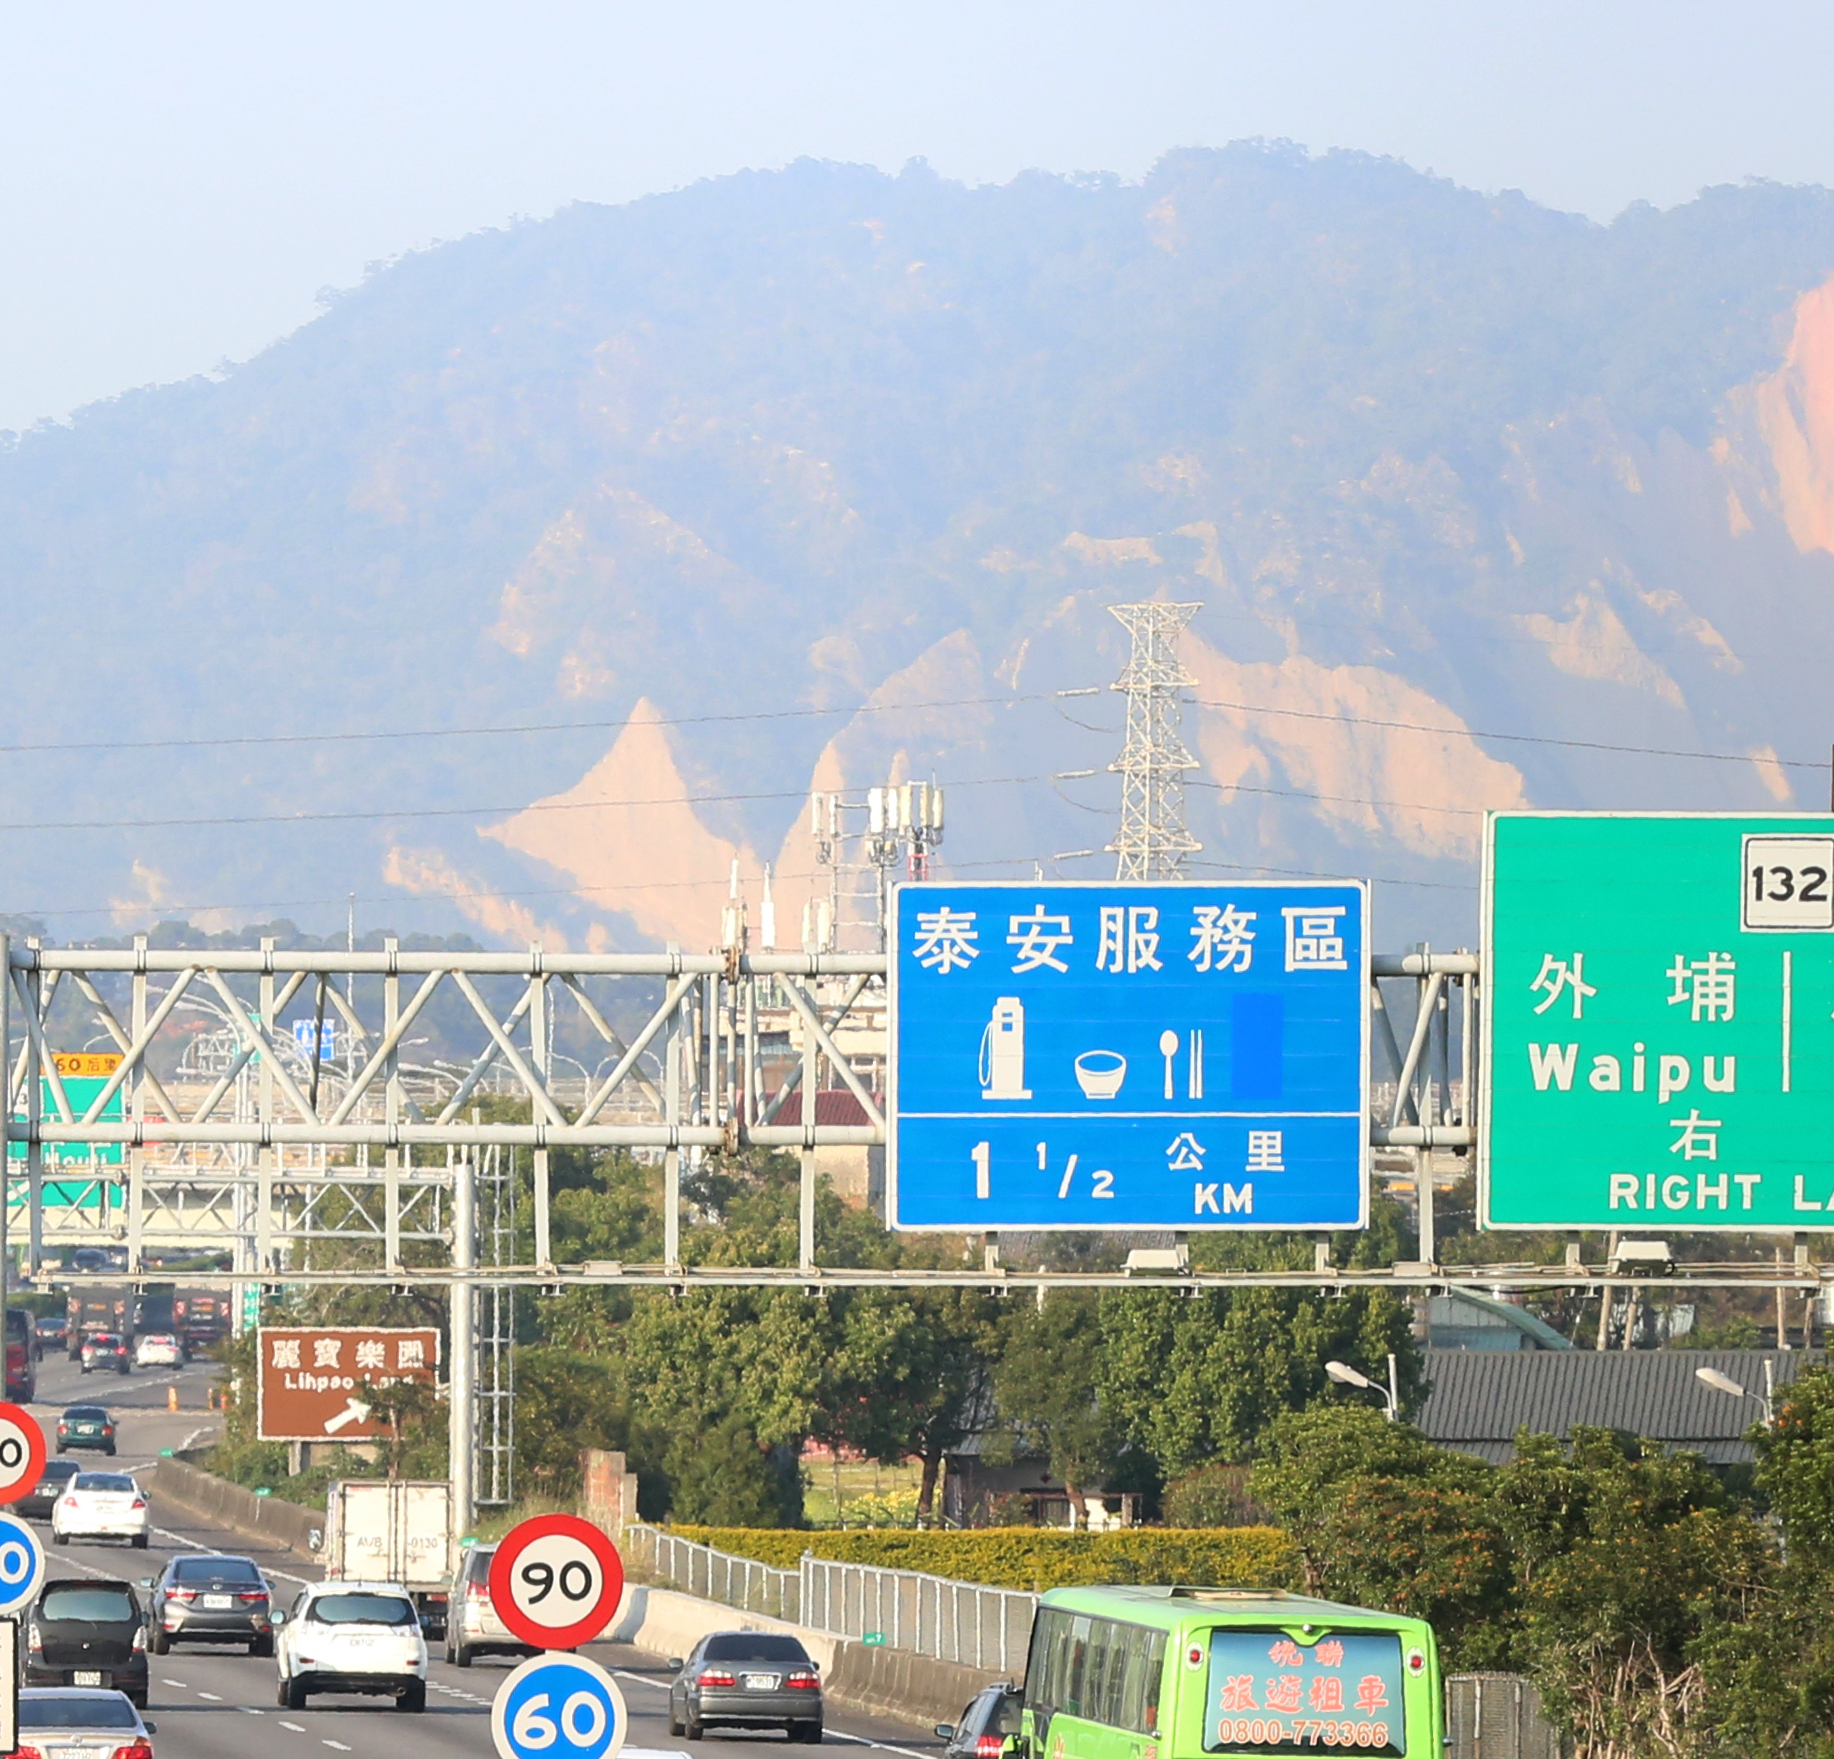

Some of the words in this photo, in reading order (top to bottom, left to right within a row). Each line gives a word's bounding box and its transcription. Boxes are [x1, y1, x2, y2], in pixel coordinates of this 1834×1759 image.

[1752, 866, 1828, 902] 132
[912, 904, 1348, 974] 泰安服務區
[1528, 952, 1737, 1022] 外埔
[1528, 1042, 1737, 1104] Waipu
[1165, 1131, 1285, 1172] 公里
[1195, 1183, 1253, 1215] KM
[1609, 1174, 1761, 1210] RIGHT
[271, 1337, 425, 1370] 麗寶樂園
[284, 1371, 355, 1393] Lihpao
[521, 1560, 593, 1605] 90
[1268, 1639, 1345, 1668] 統聯
[1219, 1673, 1390, 1717] 旅遊租車
[512, 1690, 607, 1749] 60
[1218, 1718, 1389, 1748] 0800-773366
